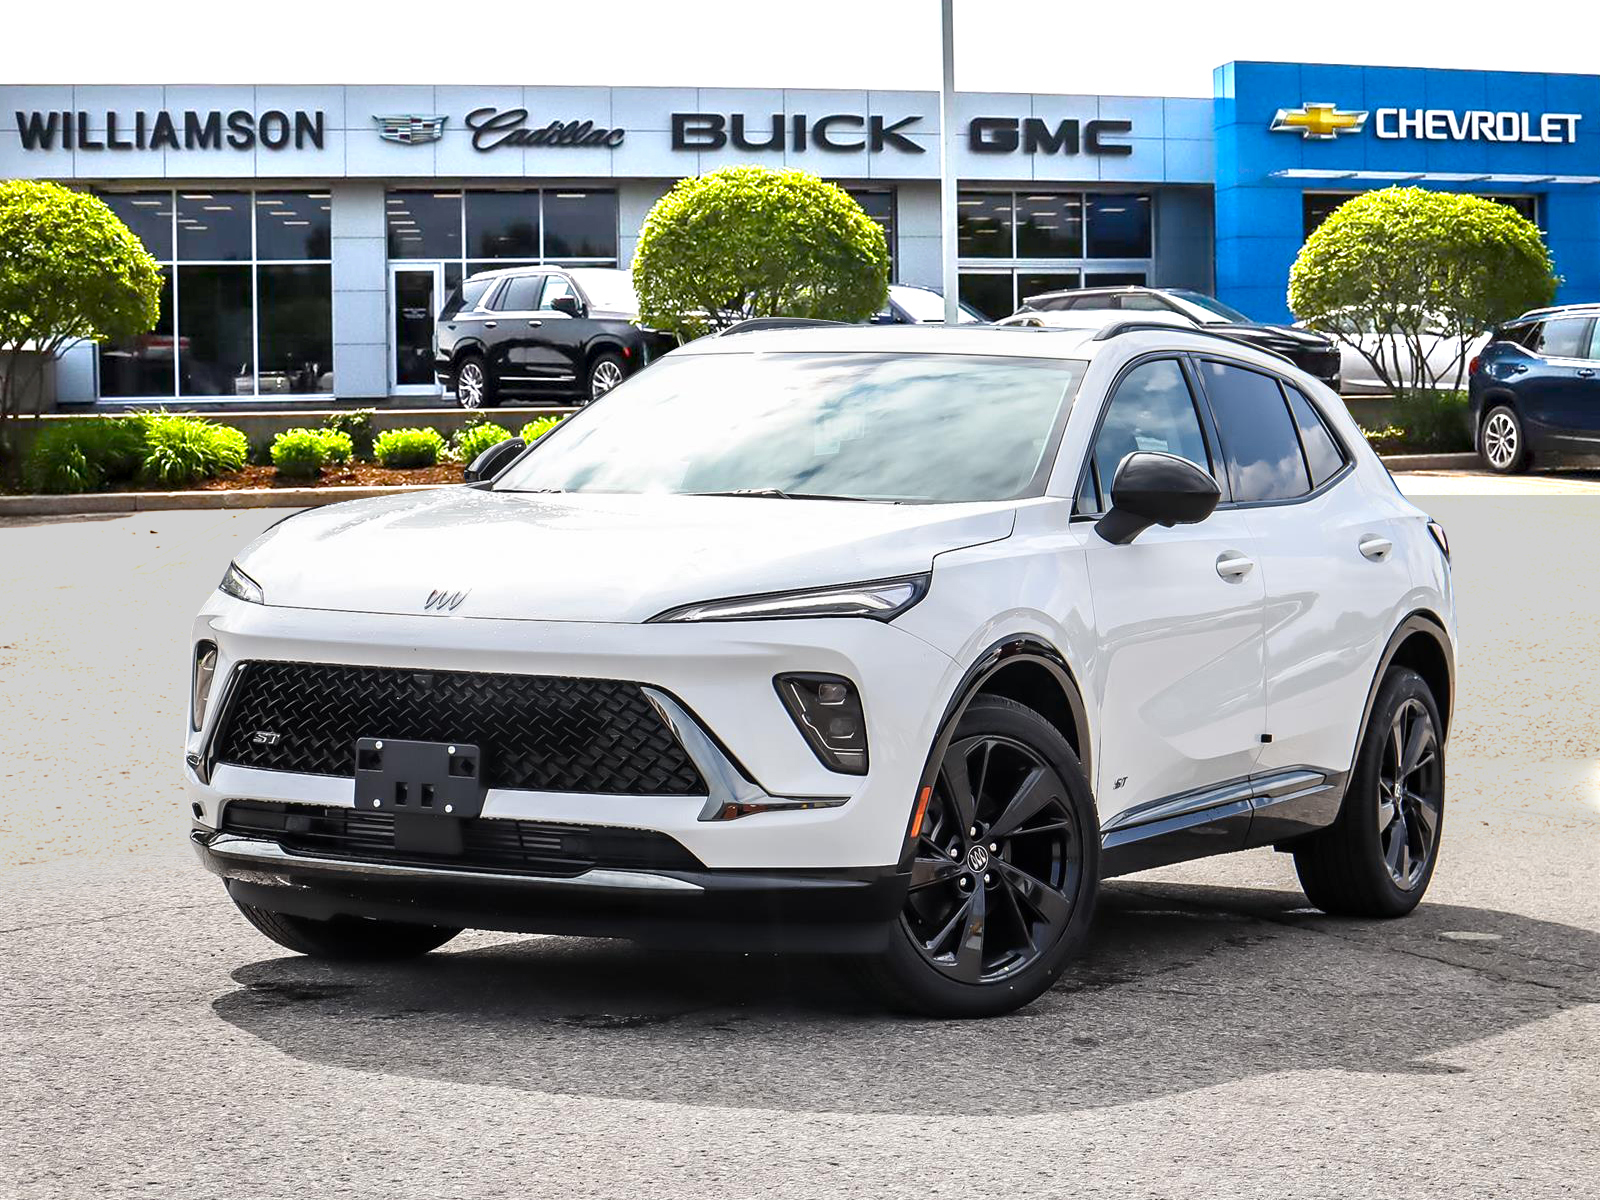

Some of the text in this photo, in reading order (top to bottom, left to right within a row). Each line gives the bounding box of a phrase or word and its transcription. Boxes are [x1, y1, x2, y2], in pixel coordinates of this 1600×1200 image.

[15, 110, 325, 151] WILLIAMSON
[464, 106, 626, 152] Cadillac
[671, 113, 927, 154] BUICK
[969, 116, 1133, 156] GMC
[1375, 107, 1583, 144] CHEVROLET
[252, 730, 281, 745] ST
